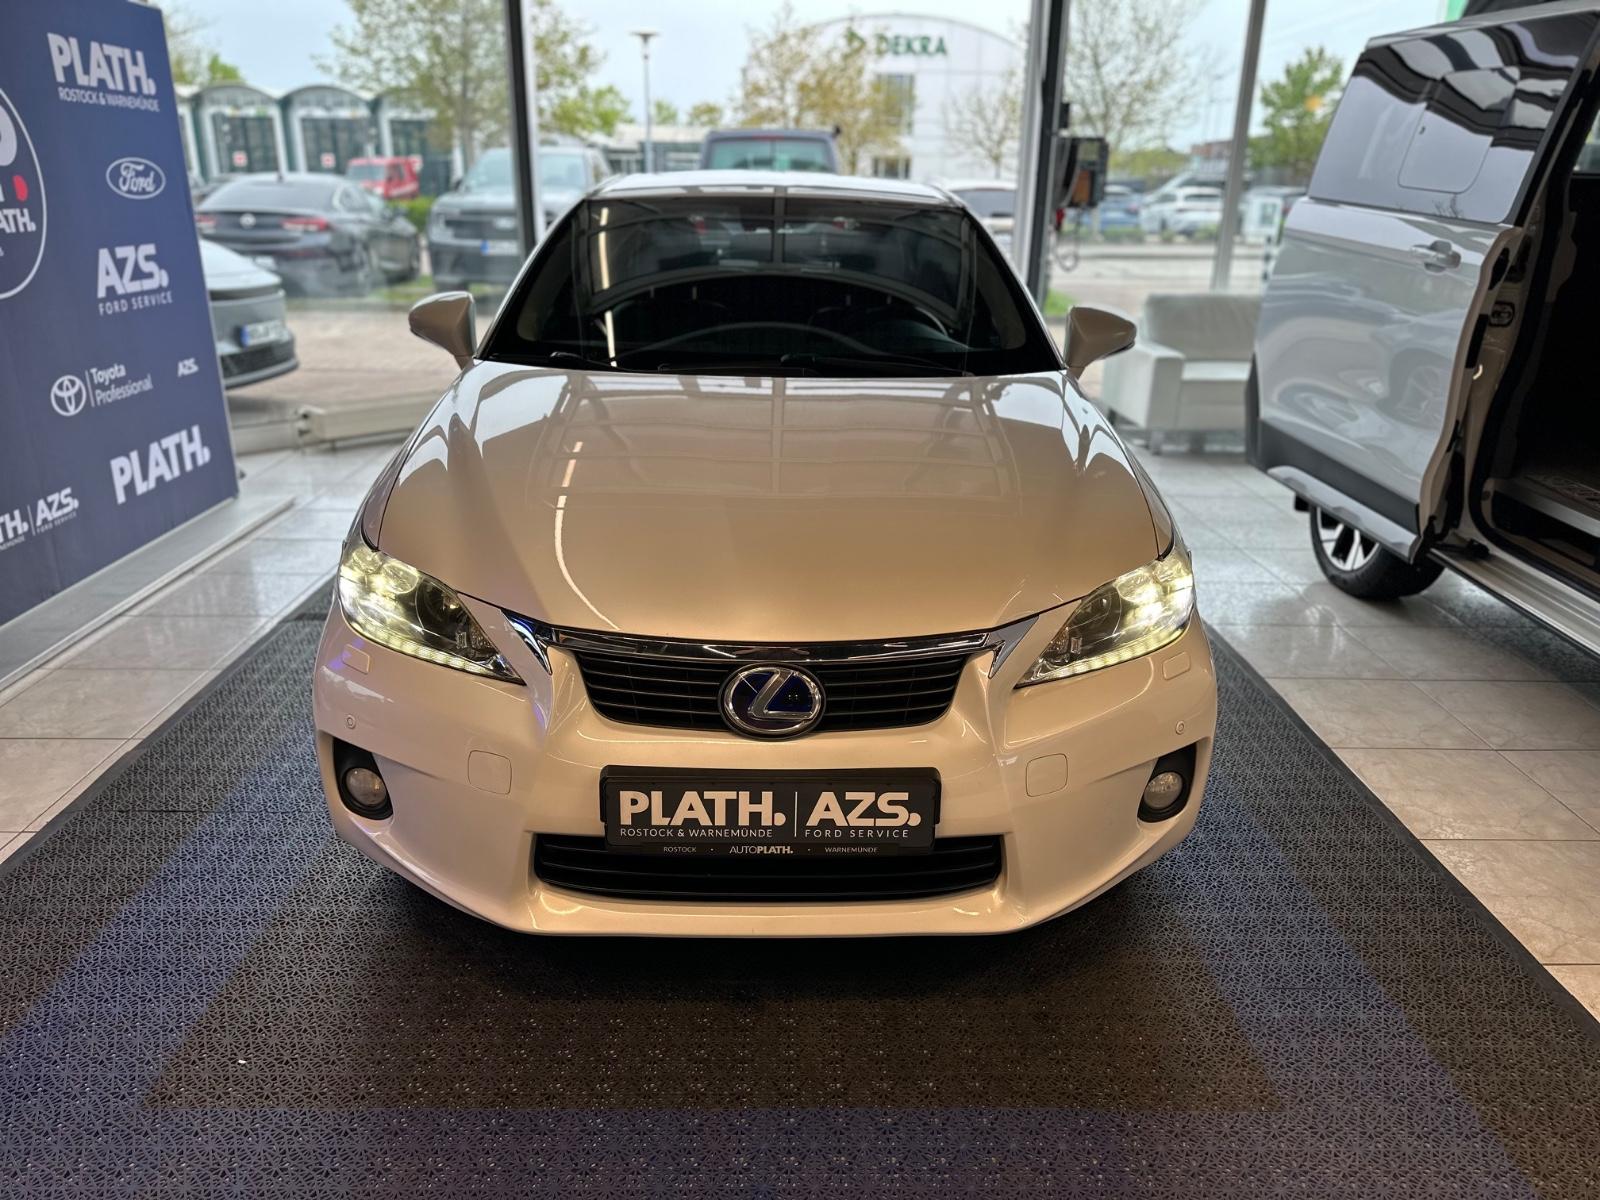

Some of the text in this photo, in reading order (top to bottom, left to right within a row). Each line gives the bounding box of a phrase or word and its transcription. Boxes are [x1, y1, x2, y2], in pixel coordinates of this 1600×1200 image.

[875, 34, 947, 56] DEKRA
[47, 33, 156, 95] PLATH.
[119, 162, 156, 192] Ford
[97, 243, 169, 298] AZS.
[99, 291, 173, 316] FORD SERVICE
[90, 363, 126, 385] Toyota
[95, 374, 153, 406] Professional
[110, 424, 211, 504] PLATH.
[36, 487, 79, 527] AZS.
[619, 790, 922, 827] PLATH. AZS.
[620, 827, 774, 838] ROSTOCK & WARNEMÜNDE
[804, 829, 910, 838] FORD SERVICE
